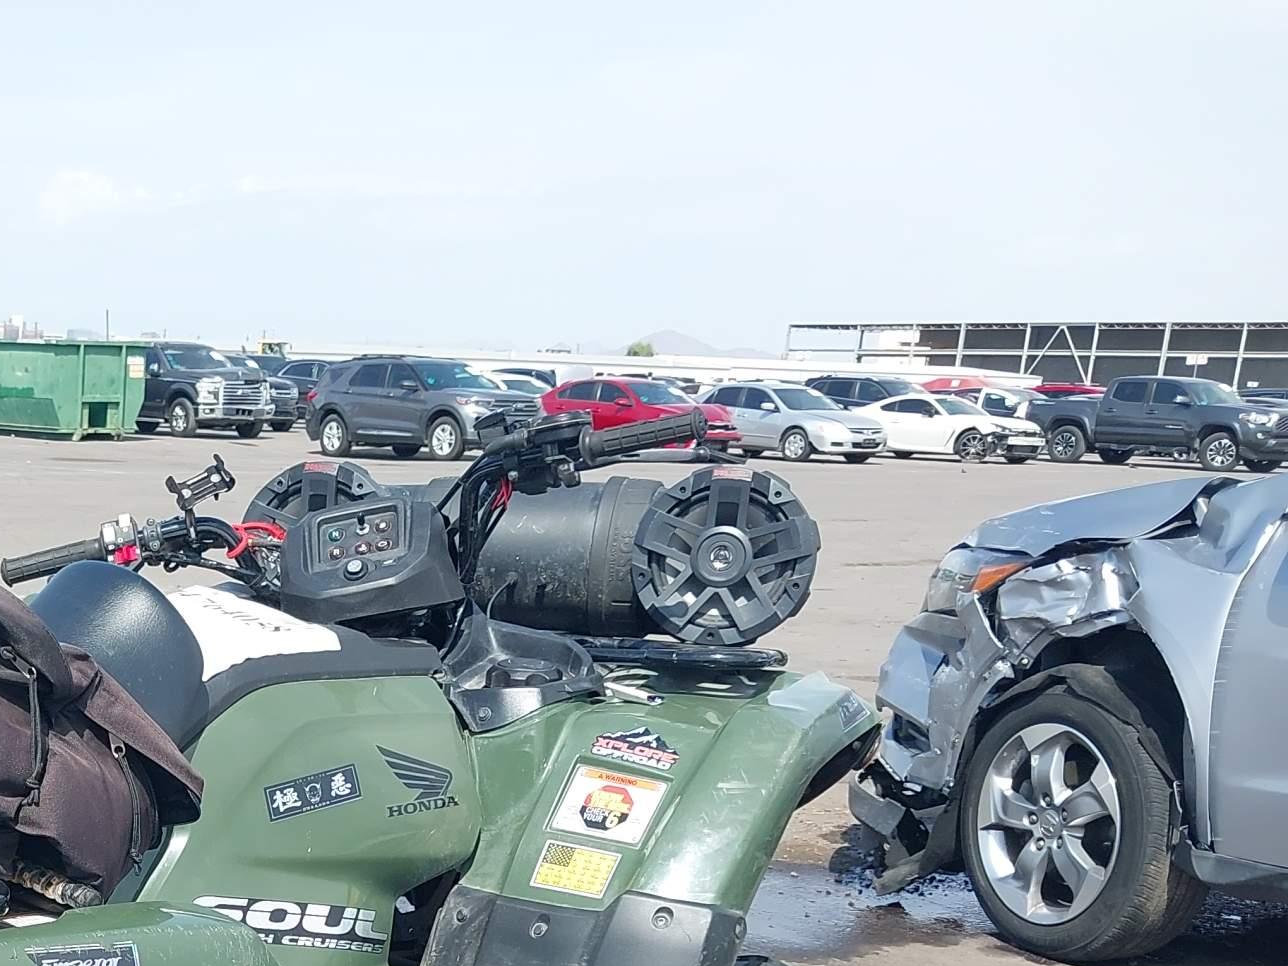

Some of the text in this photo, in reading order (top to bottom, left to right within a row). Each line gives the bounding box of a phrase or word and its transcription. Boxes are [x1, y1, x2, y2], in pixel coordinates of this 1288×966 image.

[591, 746, 672, 770] OFFROAD
[593, 736, 680, 764] XPLORE
[605, 773, 638, 787] WARNING
[387, 796, 459, 818] HONDA
[585, 806, 610, 817] CHECK
[583, 811, 622, 828] YOUR 6
[192, 895, 388, 941] SOUL
